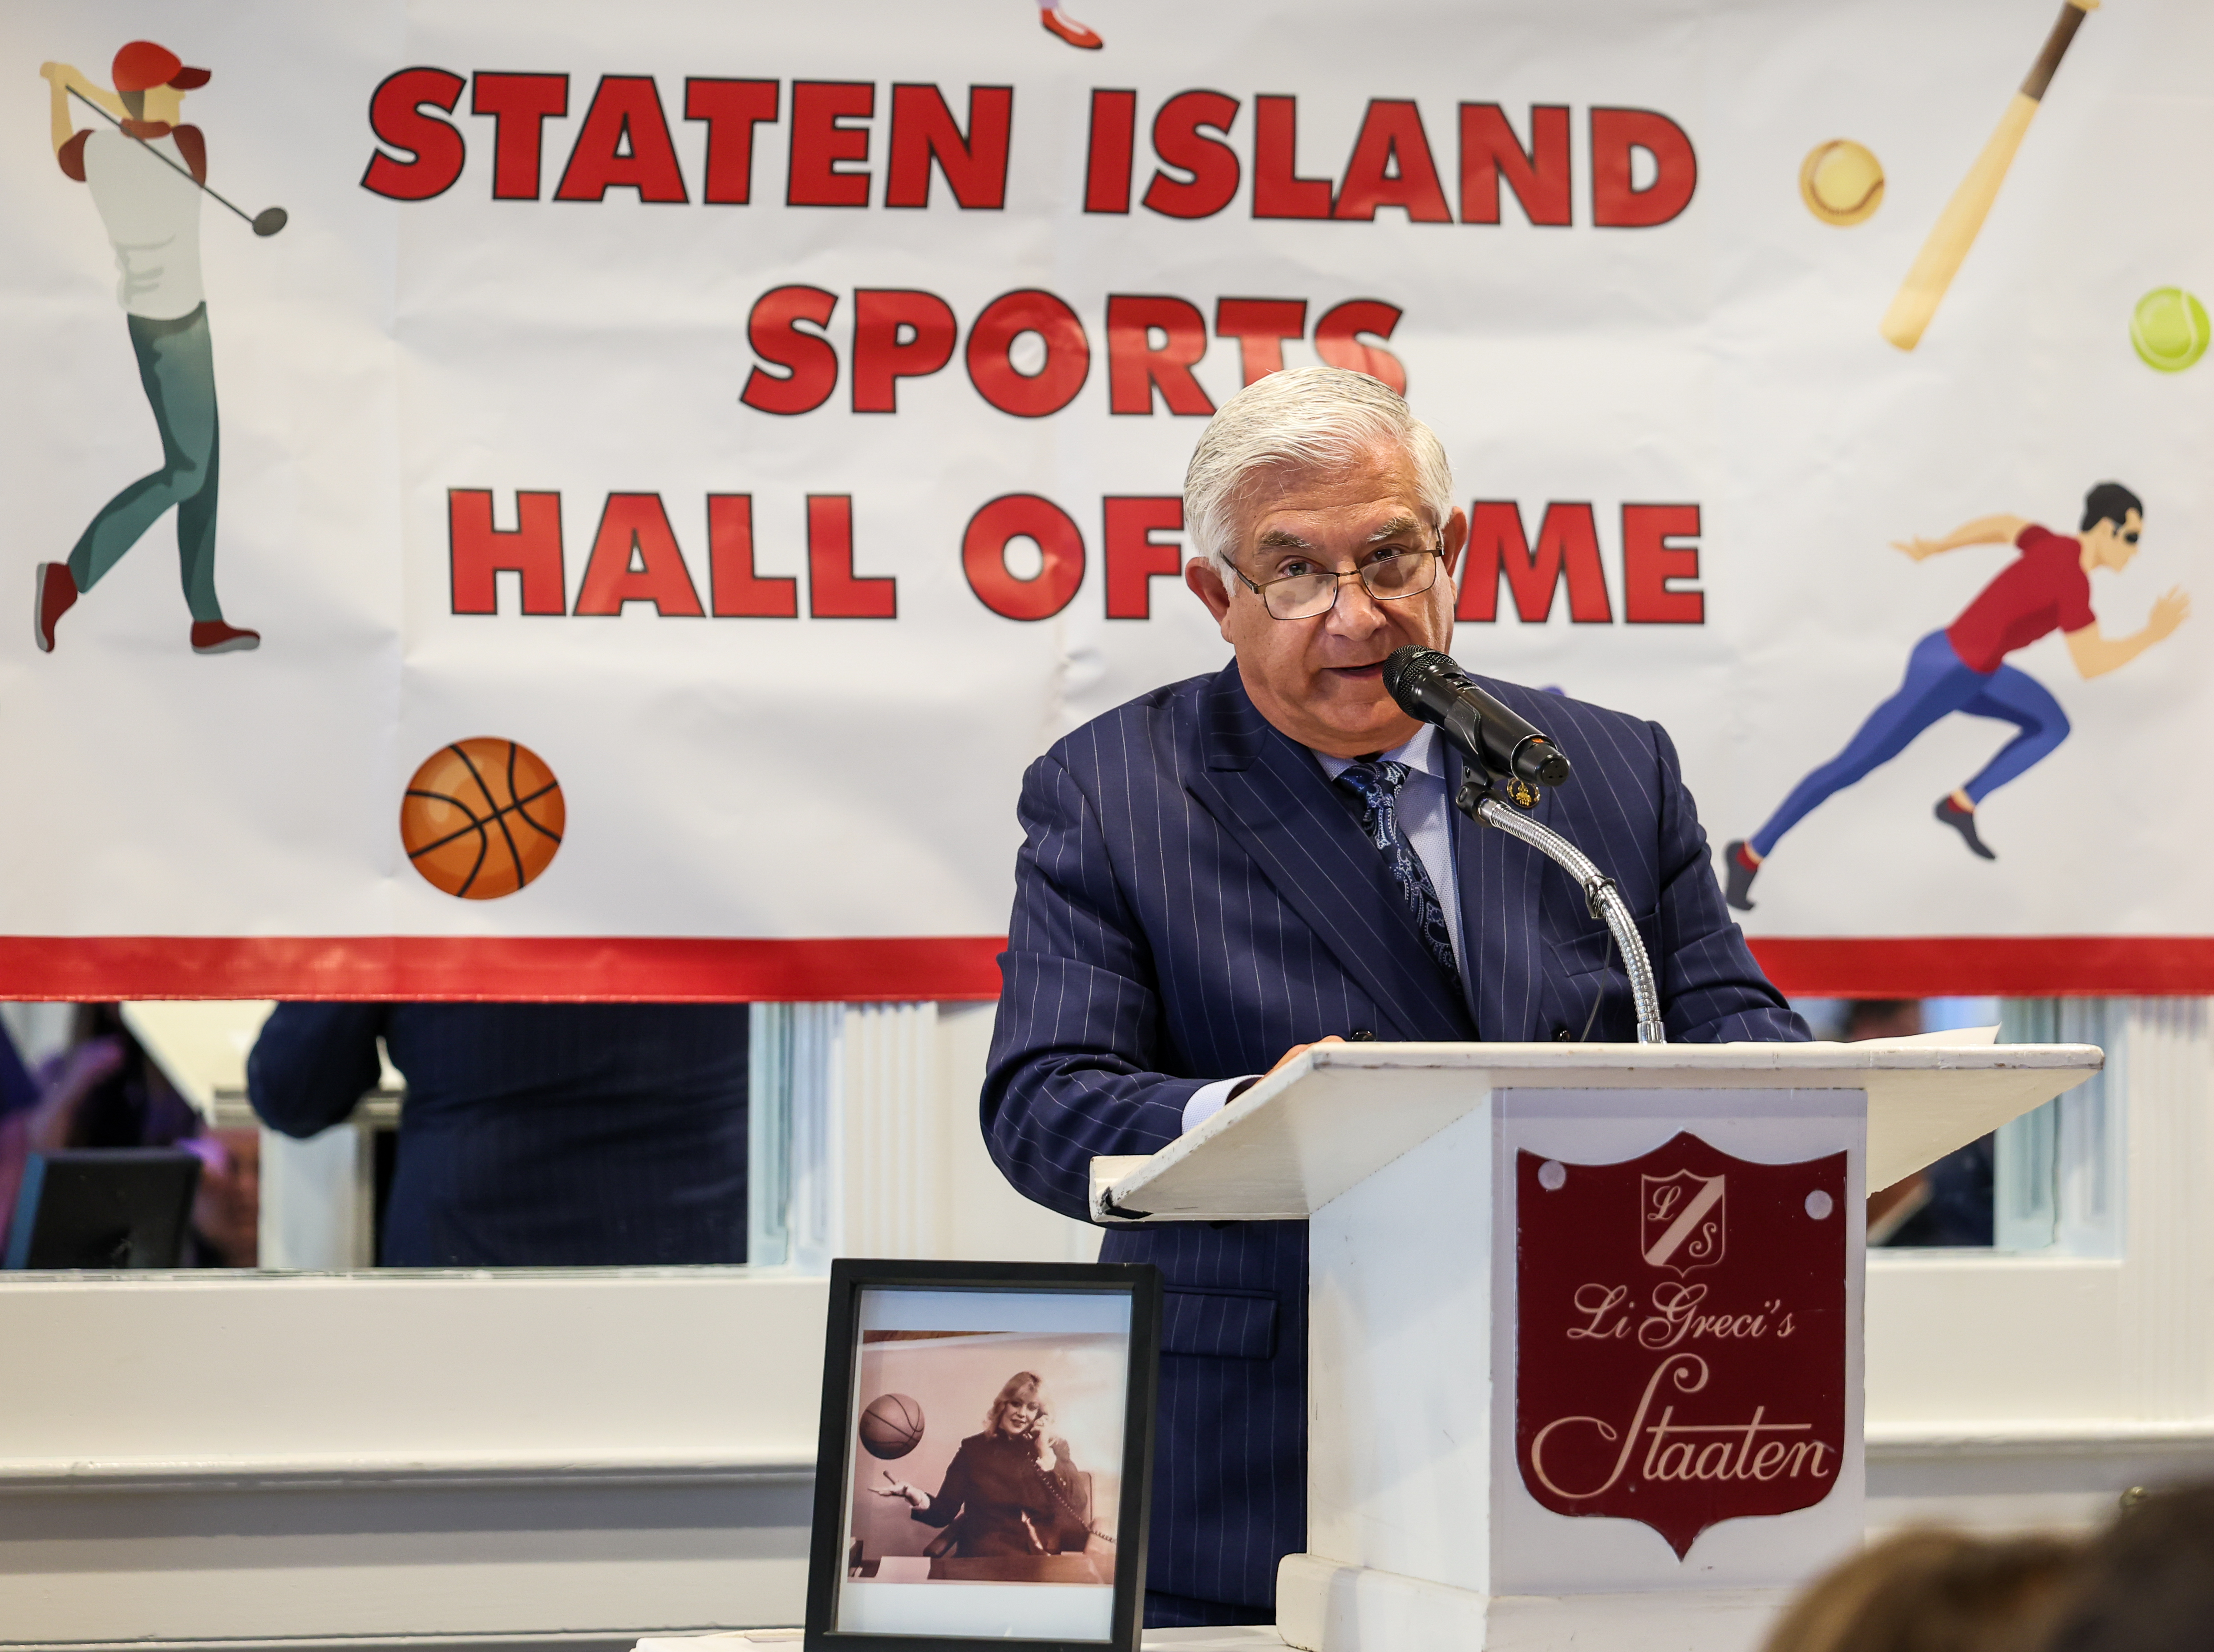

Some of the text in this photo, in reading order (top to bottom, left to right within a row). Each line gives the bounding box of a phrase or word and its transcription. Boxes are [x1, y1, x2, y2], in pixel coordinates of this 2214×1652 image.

[360, 66, 1697, 228] STATEN ISLAND
[739, 284, 1408, 419] SPORTS
[448, 489, 1706, 624] HALL OF ME
[1566, 1281, 1796, 1350] Li Greci's
[1530, 1353, 1829, 1499] Staaten
